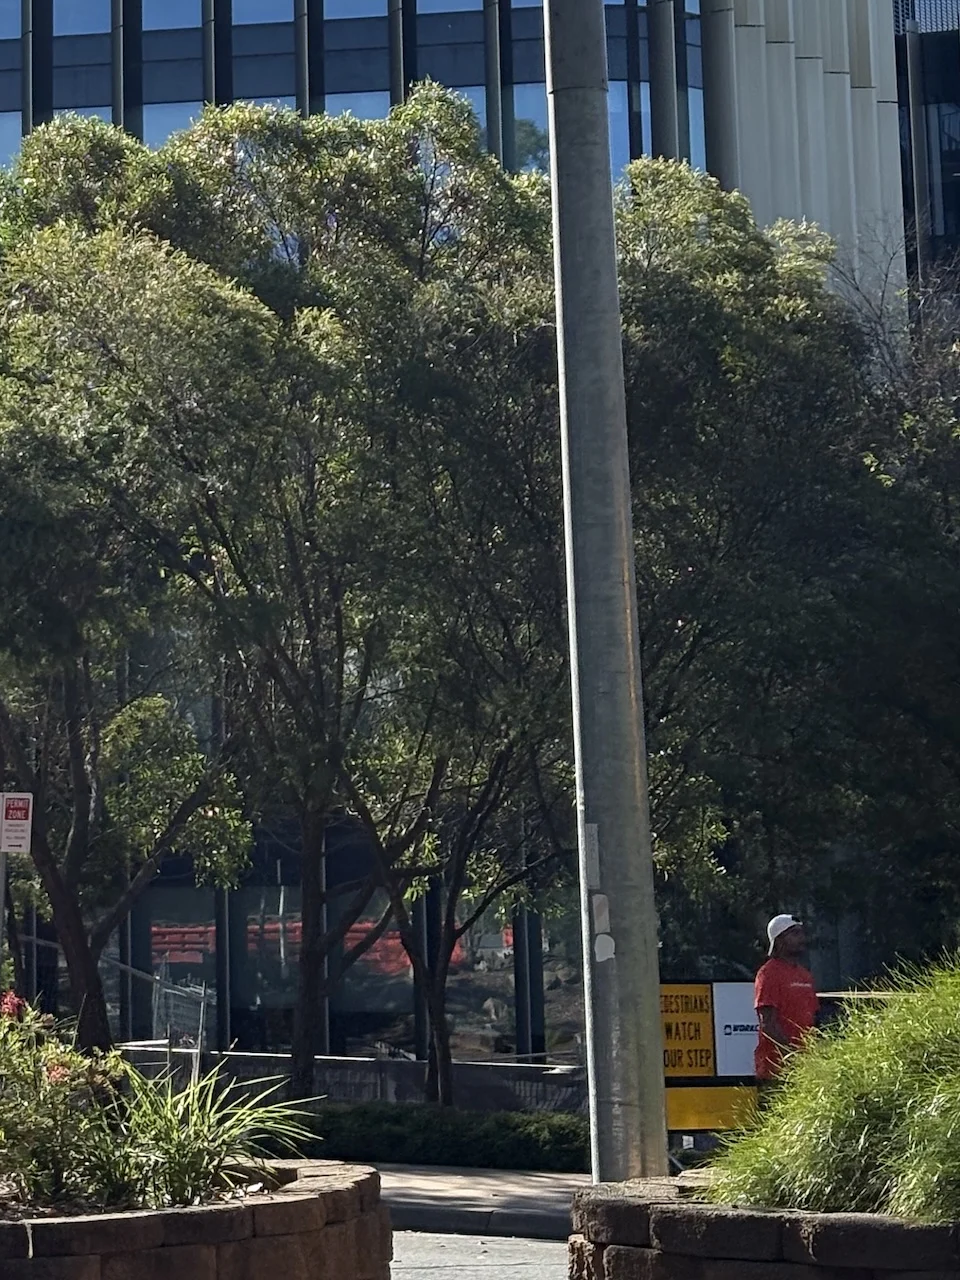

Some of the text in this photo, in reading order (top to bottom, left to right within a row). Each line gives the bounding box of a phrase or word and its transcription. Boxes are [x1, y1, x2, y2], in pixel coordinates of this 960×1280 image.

[6, 799, 29, 809] PERMIT
[7, 809, 27, 819] ZONE
[659, 994, 710, 1014] EDESTRIANS
[664, 1022, 701, 1041] WATCH
[663, 1049, 711, 1068] OUR STEP
